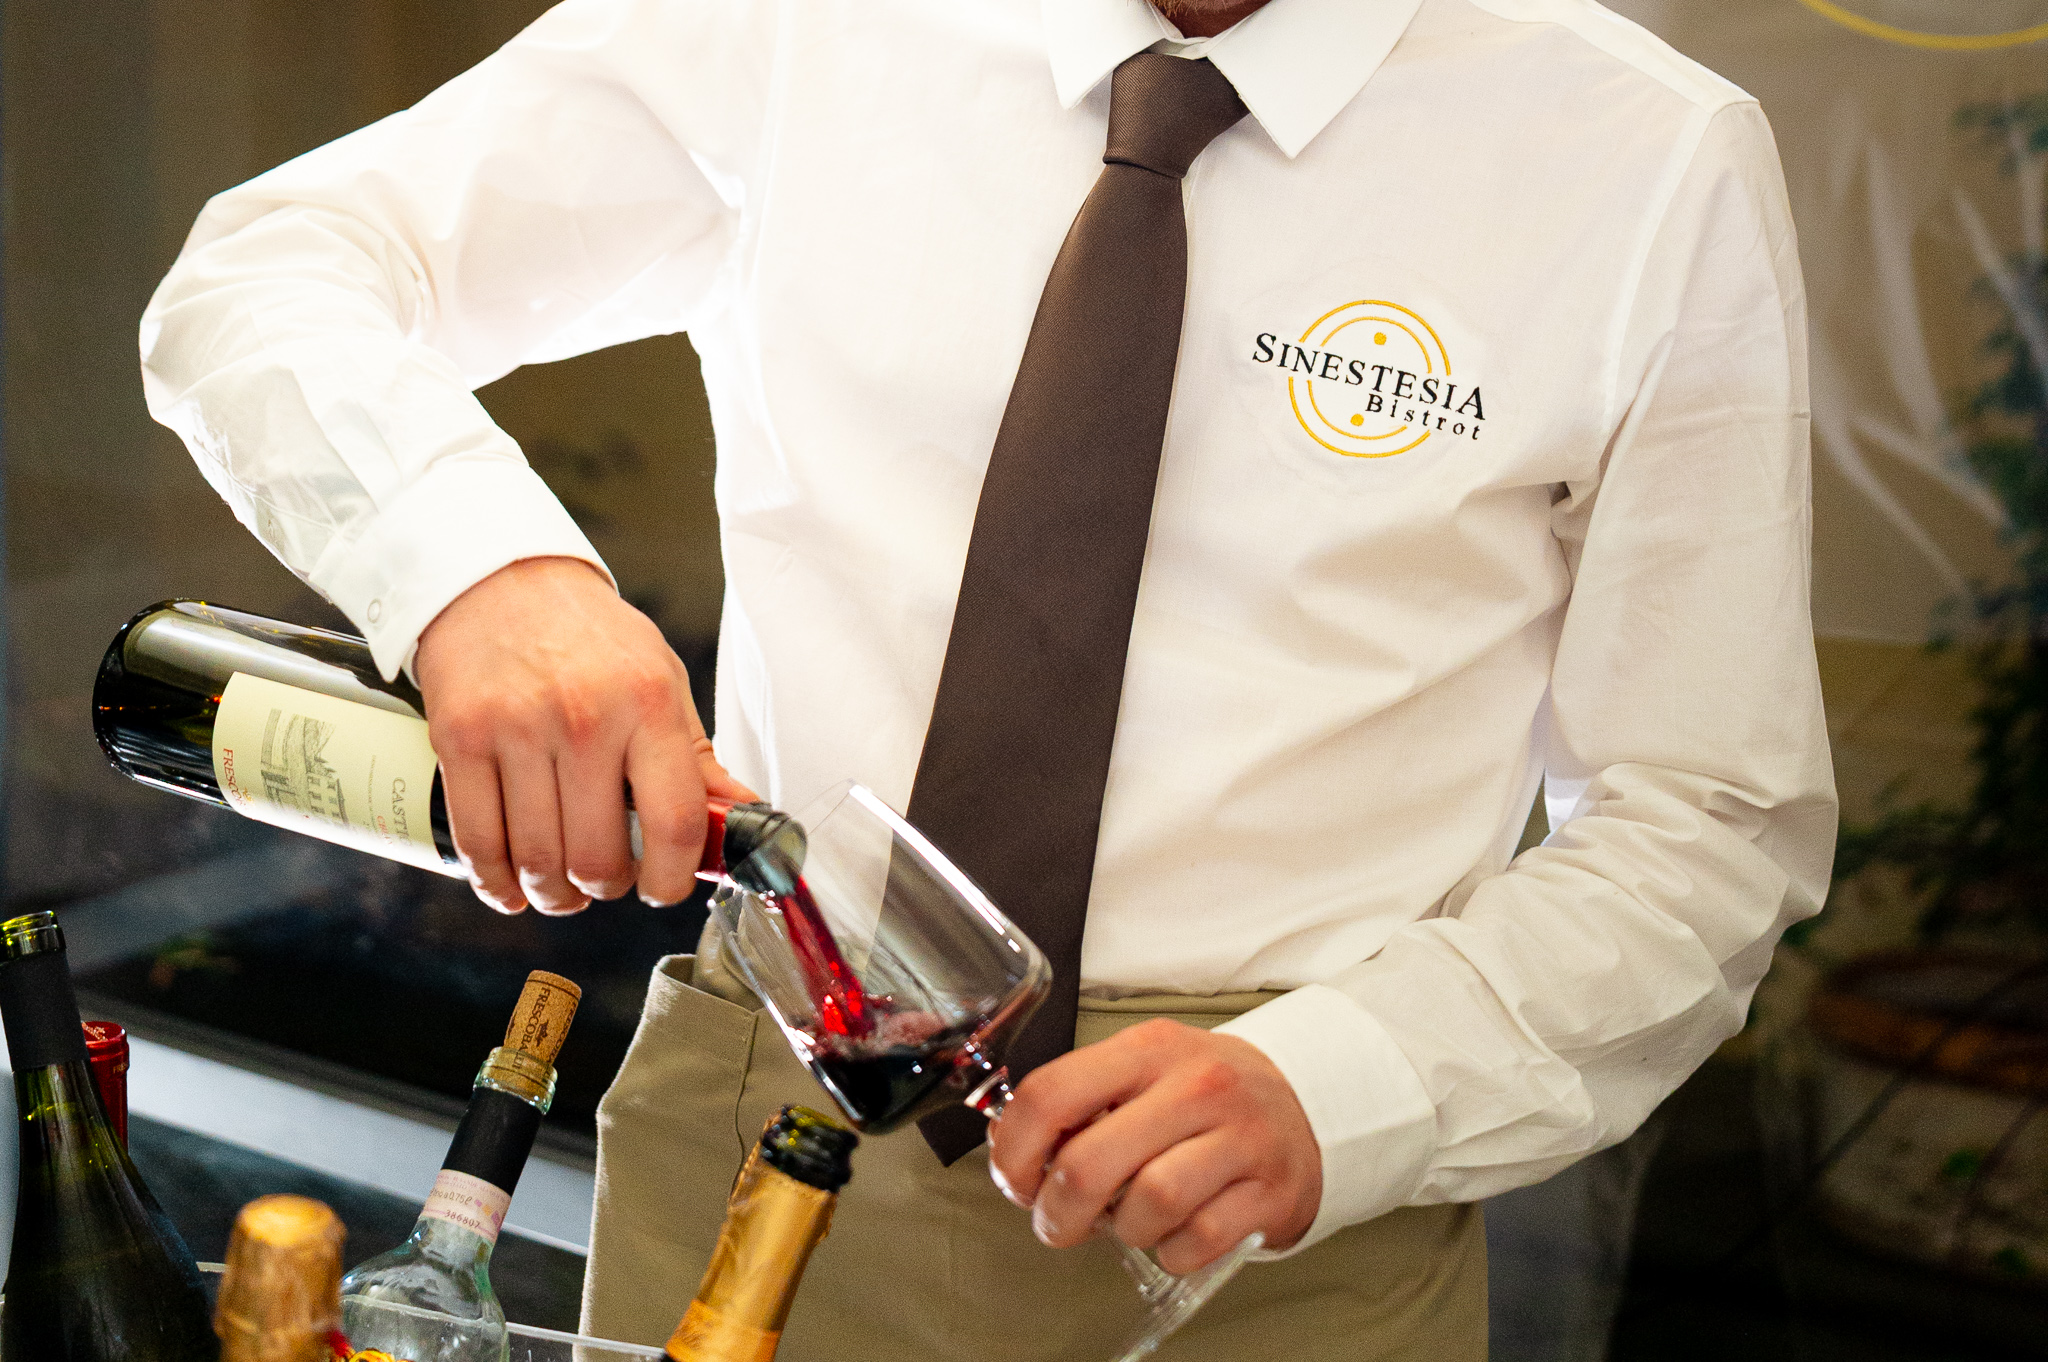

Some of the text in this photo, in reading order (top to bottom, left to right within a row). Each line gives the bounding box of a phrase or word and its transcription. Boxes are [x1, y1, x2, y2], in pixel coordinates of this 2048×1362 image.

[1252, 333, 1486, 421] SINESTESIA
[1365, 393, 1481, 440] Bistrot
[444, 1209, 480, 1228] 386807
